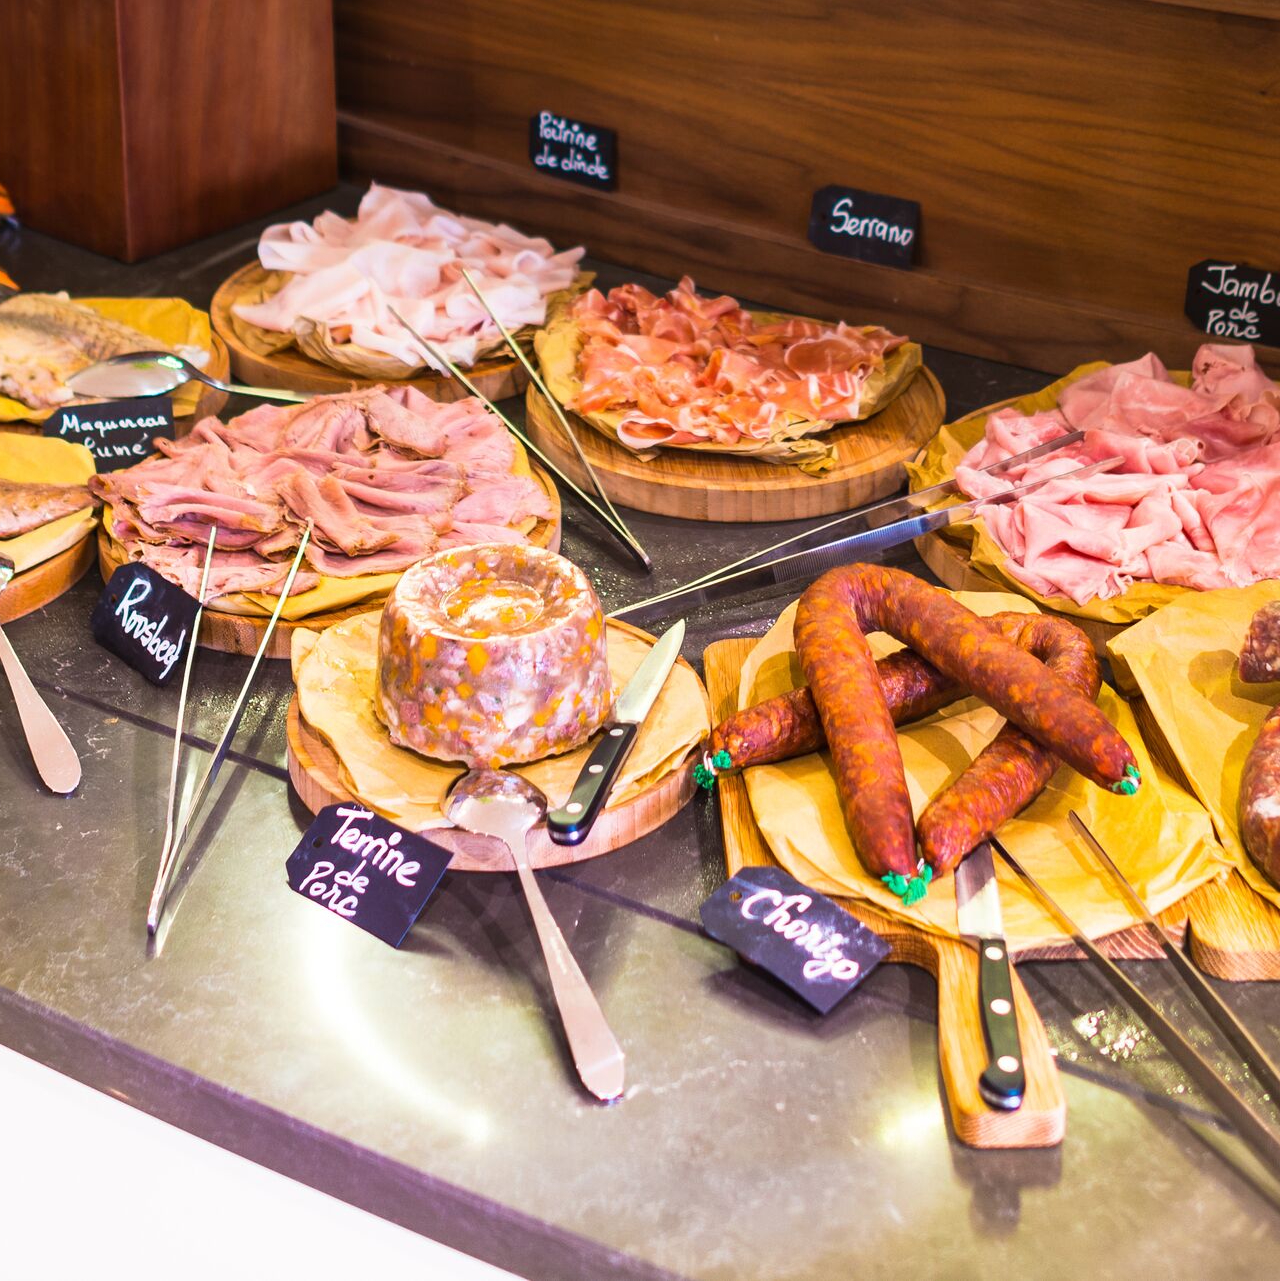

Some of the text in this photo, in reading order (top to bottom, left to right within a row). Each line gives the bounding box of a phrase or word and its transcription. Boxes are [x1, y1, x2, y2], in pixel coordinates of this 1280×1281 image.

[539, 110, 598, 152] Poitrine
[534, 143, 611, 180] de dinde
[830, 197, 915, 246] Serrano
[1206, 308, 1262, 340] Porc
[1228, 299, 1261, 324] de
[330, 806, 421, 888] Terrine
[298, 860, 360, 918] Porc
[333, 859, 370, 894] de
[740, 888, 860, 981] Chorizo
